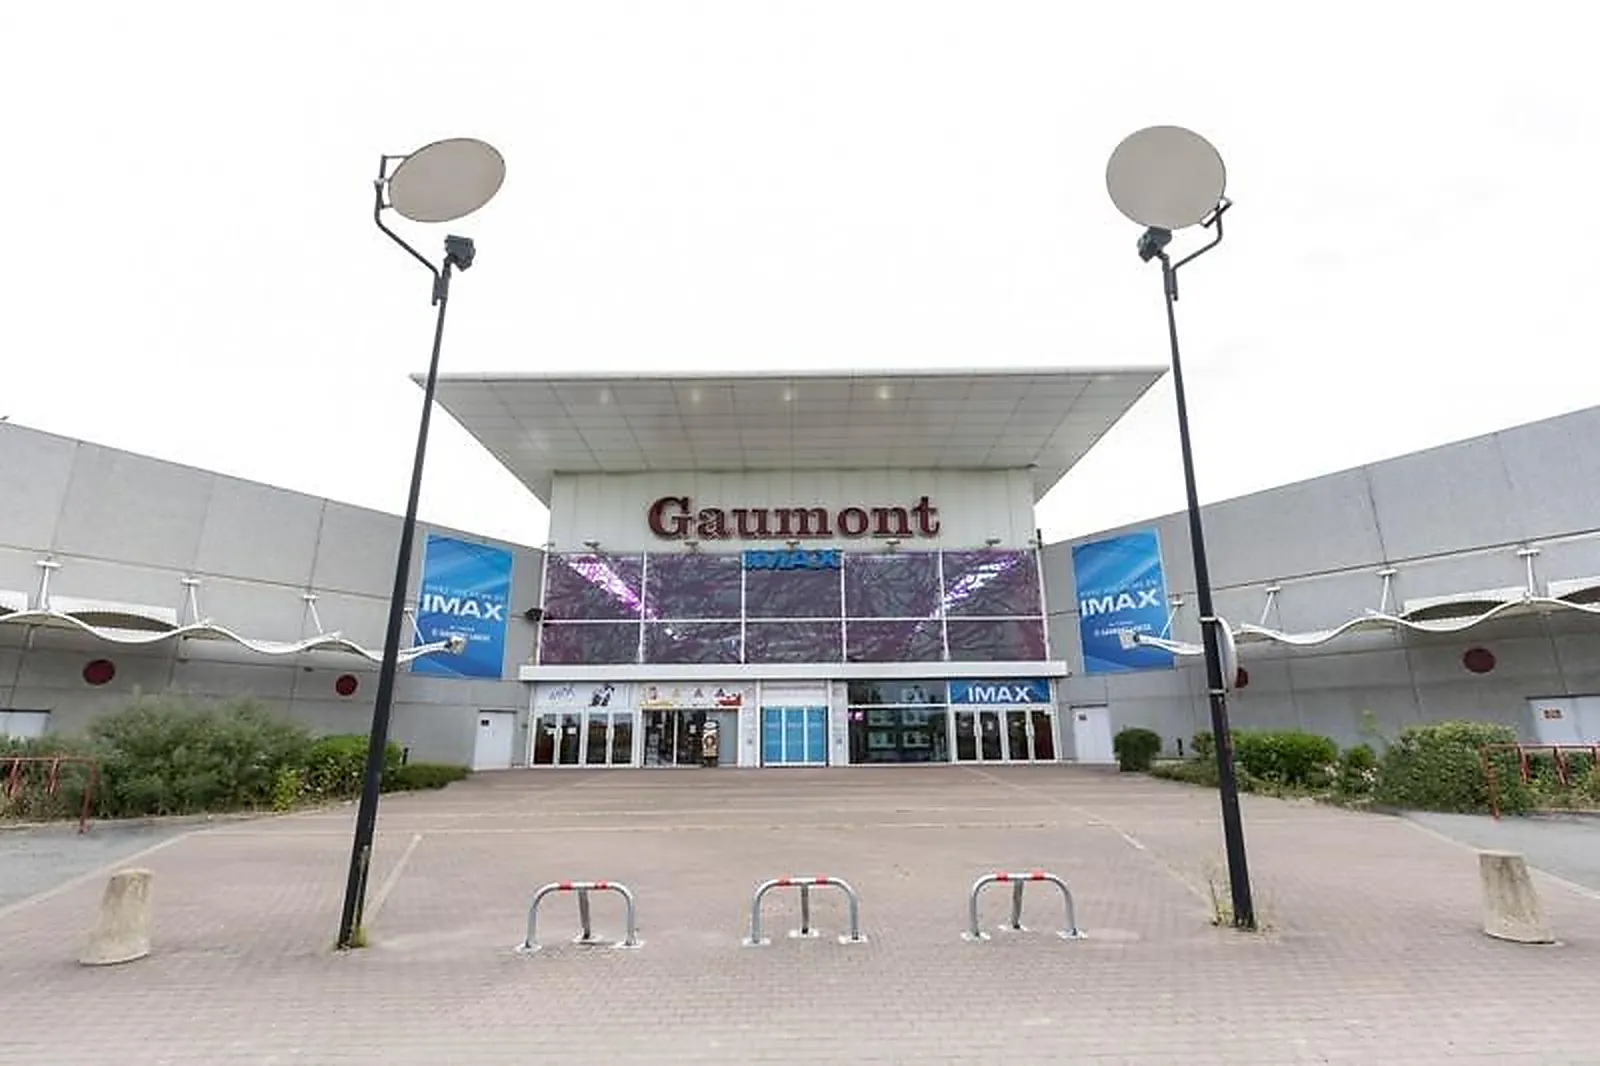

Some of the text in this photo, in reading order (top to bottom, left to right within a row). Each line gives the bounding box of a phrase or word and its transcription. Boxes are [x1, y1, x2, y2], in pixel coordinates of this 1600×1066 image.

[648, 495, 940, 538] Gaumont
[422, 593, 504, 622] IMAX
[1080, 588, 1161, 616] IMAX
[968, 685, 1032, 703] IMAX
